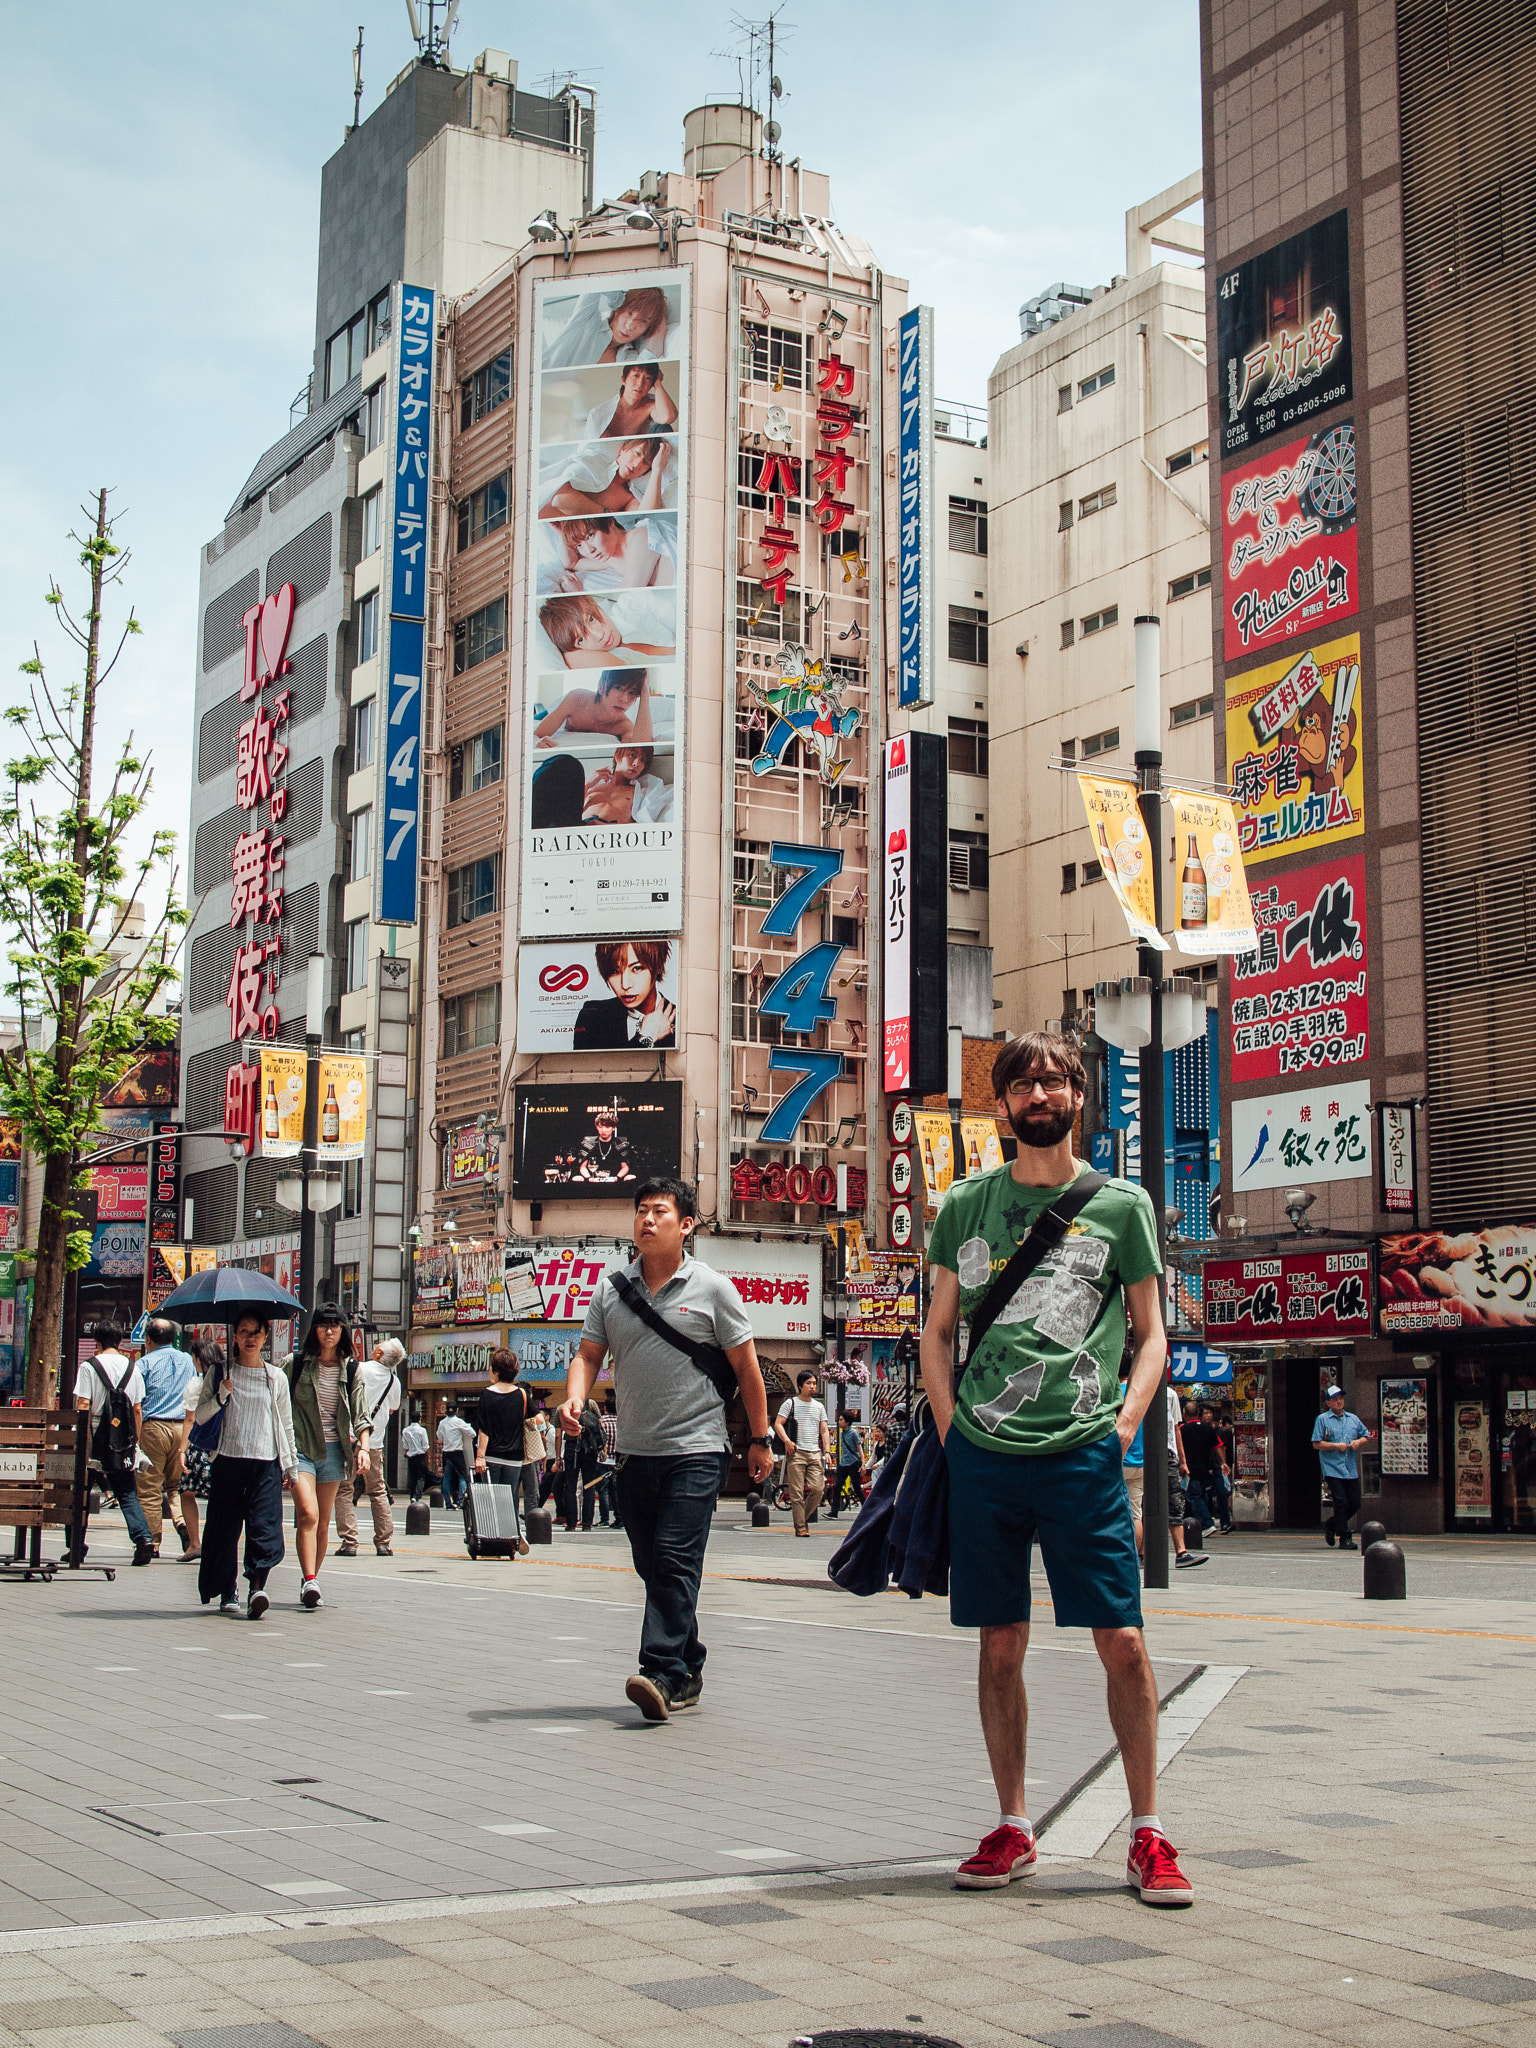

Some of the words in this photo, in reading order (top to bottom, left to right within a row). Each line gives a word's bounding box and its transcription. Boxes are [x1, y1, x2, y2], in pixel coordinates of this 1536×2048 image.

[1221, 273, 1239, 299] 4F
[1238, 307, 1342, 410] 戸灯路
[902, 326, 918, 435] 747
[1283, 384, 1346, 422] 03-6205-5096
[1227, 423, 1246, 438] OPEN
[1256, 409, 1276, 425] 16:00
[1227, 432, 1249, 449] CLOSE
[1259, 420, 1276, 434] 5:00
[398, 295, 429, 595] カラオケ&パーティー
[812, 354, 855, 535] カラオケ
[1229, 453, 1317, 524] ダイニング
[1261, 508, 1276, 530] &
[1231, 519, 1320, 578] ダーツバー
[901, 448, 920, 692] カラオケランド
[1285, 619, 1299, 634] 8F
[1261, 665, 1318, 732] 低料金
[385, 673, 421, 861] 747
[1232, 745, 1300, 806] 麻雀
[1180, 812, 1232, 832] 東京づくり
[1237, 786, 1353, 851] ウェルカム
[532, 830, 673, 853] RAINGROUP
[889, 856, 906, 943] マルハン
[1220, 930, 1249, 938] TOKYO
[1283, 877, 1361, 969] 一休
[757, 841, 847, 1143] 747
[1233, 1010, 1347, 1054] 伝説の手羽先
[264, 1065, 304, 1075] 東京づくり
[1279, 1034, 1367, 1073] 1本99円!
[324, 1069, 364, 1079] 東京づくり
[895, 1113, 905, 1131] 売
[1300, 1100, 1340, 1123] 焼肉
[1279, 1114, 1367, 1168] 叙々苑
[1388, 1108, 1407, 1185] きづなすし
[1244, 1265, 1253, 1277] 2F
[1327, 1257, 1337, 1271] 3F
[1473, 1243, 1536, 1302] きづ
[464, 1280, 478, 1292] LOVE
[1207, 1301, 1237, 1325] 居酒屋
[1237, 1281, 1281, 1326] 一休
[1288, 1297, 1317, 1320] 焼鳥
[1319, 1275, 1368, 1321] 一休
[800, 1322, 811, 1332] B1
[1387, 1302, 1411, 1313] 24時間
[1394, 1314, 1462, 1328] 03-5287-1081
[433, 1345, 491, 1373] 無料案内所
